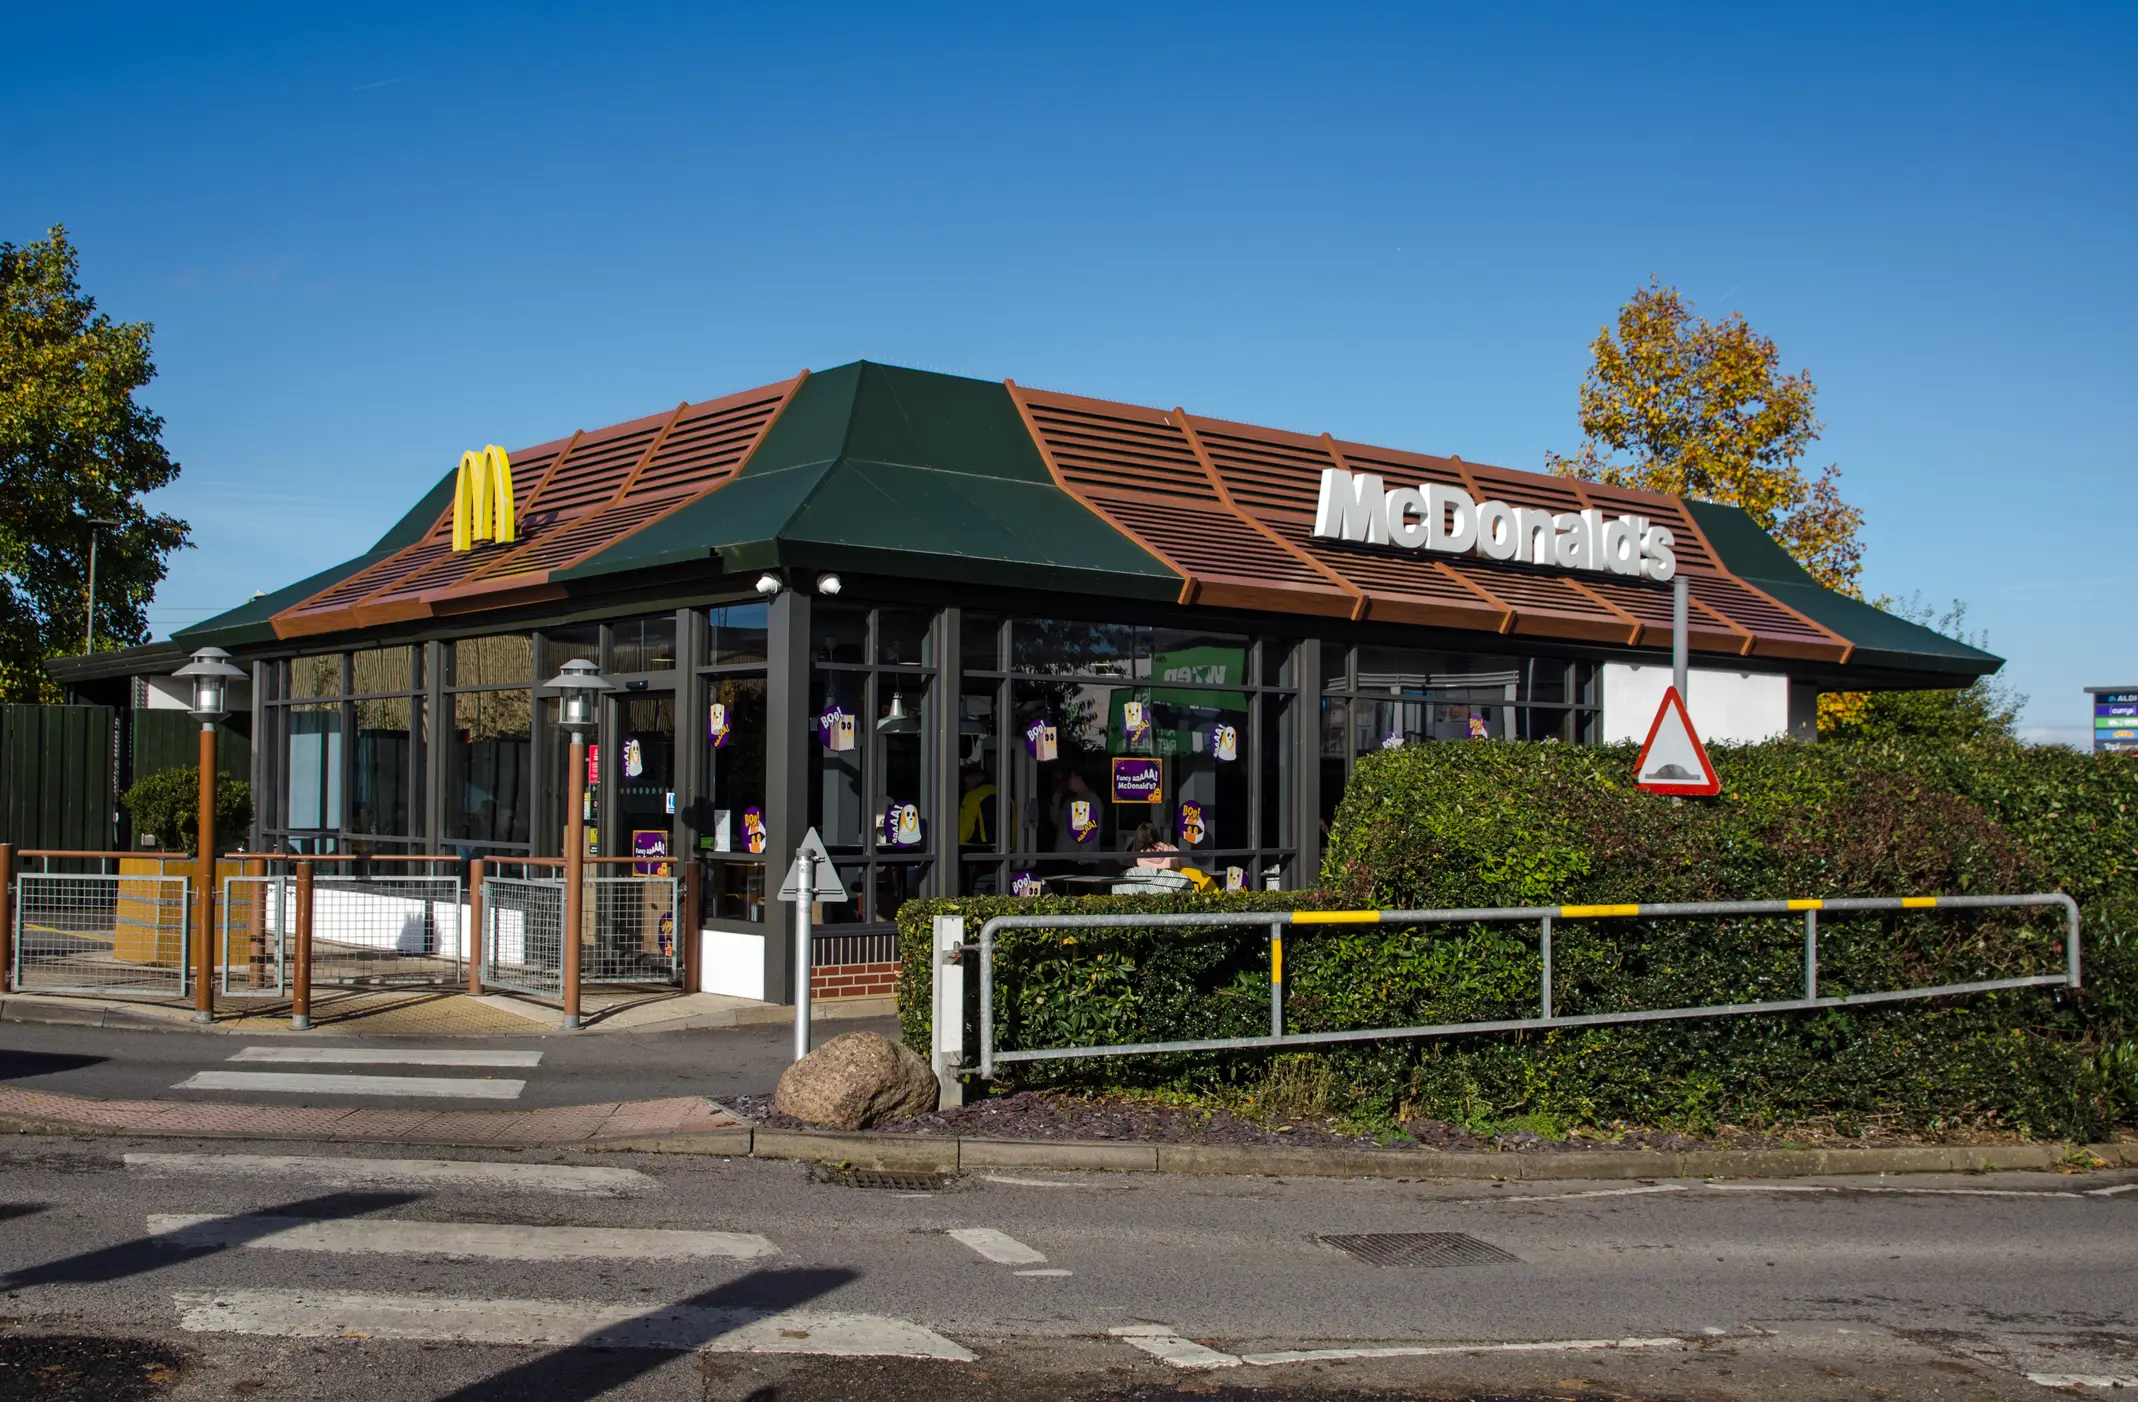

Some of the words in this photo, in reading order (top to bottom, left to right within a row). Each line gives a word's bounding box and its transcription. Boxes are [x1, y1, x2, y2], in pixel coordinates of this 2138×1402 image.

[1314, 468, 1676, 581] McDonald's
[820, 706, 843, 729] BOO!
[1026, 720, 1046, 742] BOO!
[1118, 782, 1157, 790] McDonald's?
